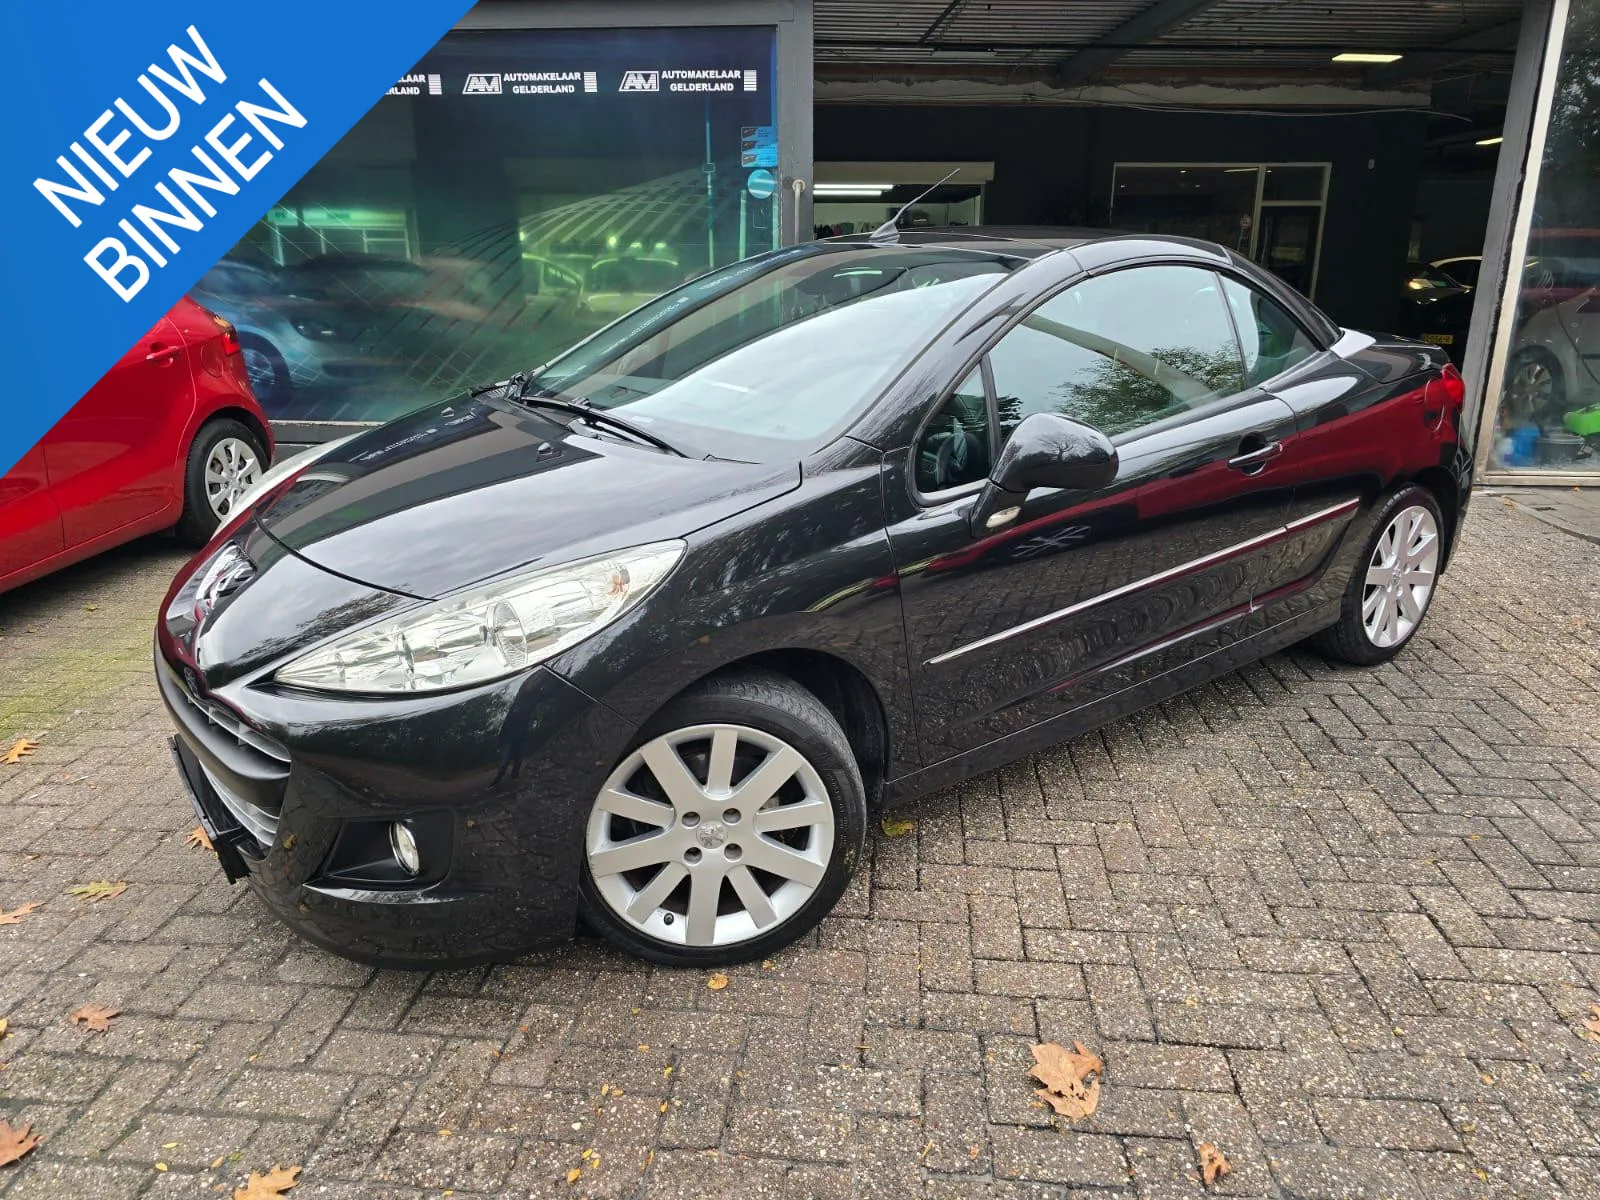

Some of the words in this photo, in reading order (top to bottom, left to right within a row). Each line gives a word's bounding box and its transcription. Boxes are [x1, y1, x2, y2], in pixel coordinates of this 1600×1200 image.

[503, 72, 582, 82] AUTOMAKELAAR
[661, 70, 741, 80] AUTOMAKELAAR
[465, 75, 501, 93] AM
[622, 72, 658, 91] AM
[512, 84, 575, 95] GELDERLAND
[670, 82, 735, 92] GELDERLAND
